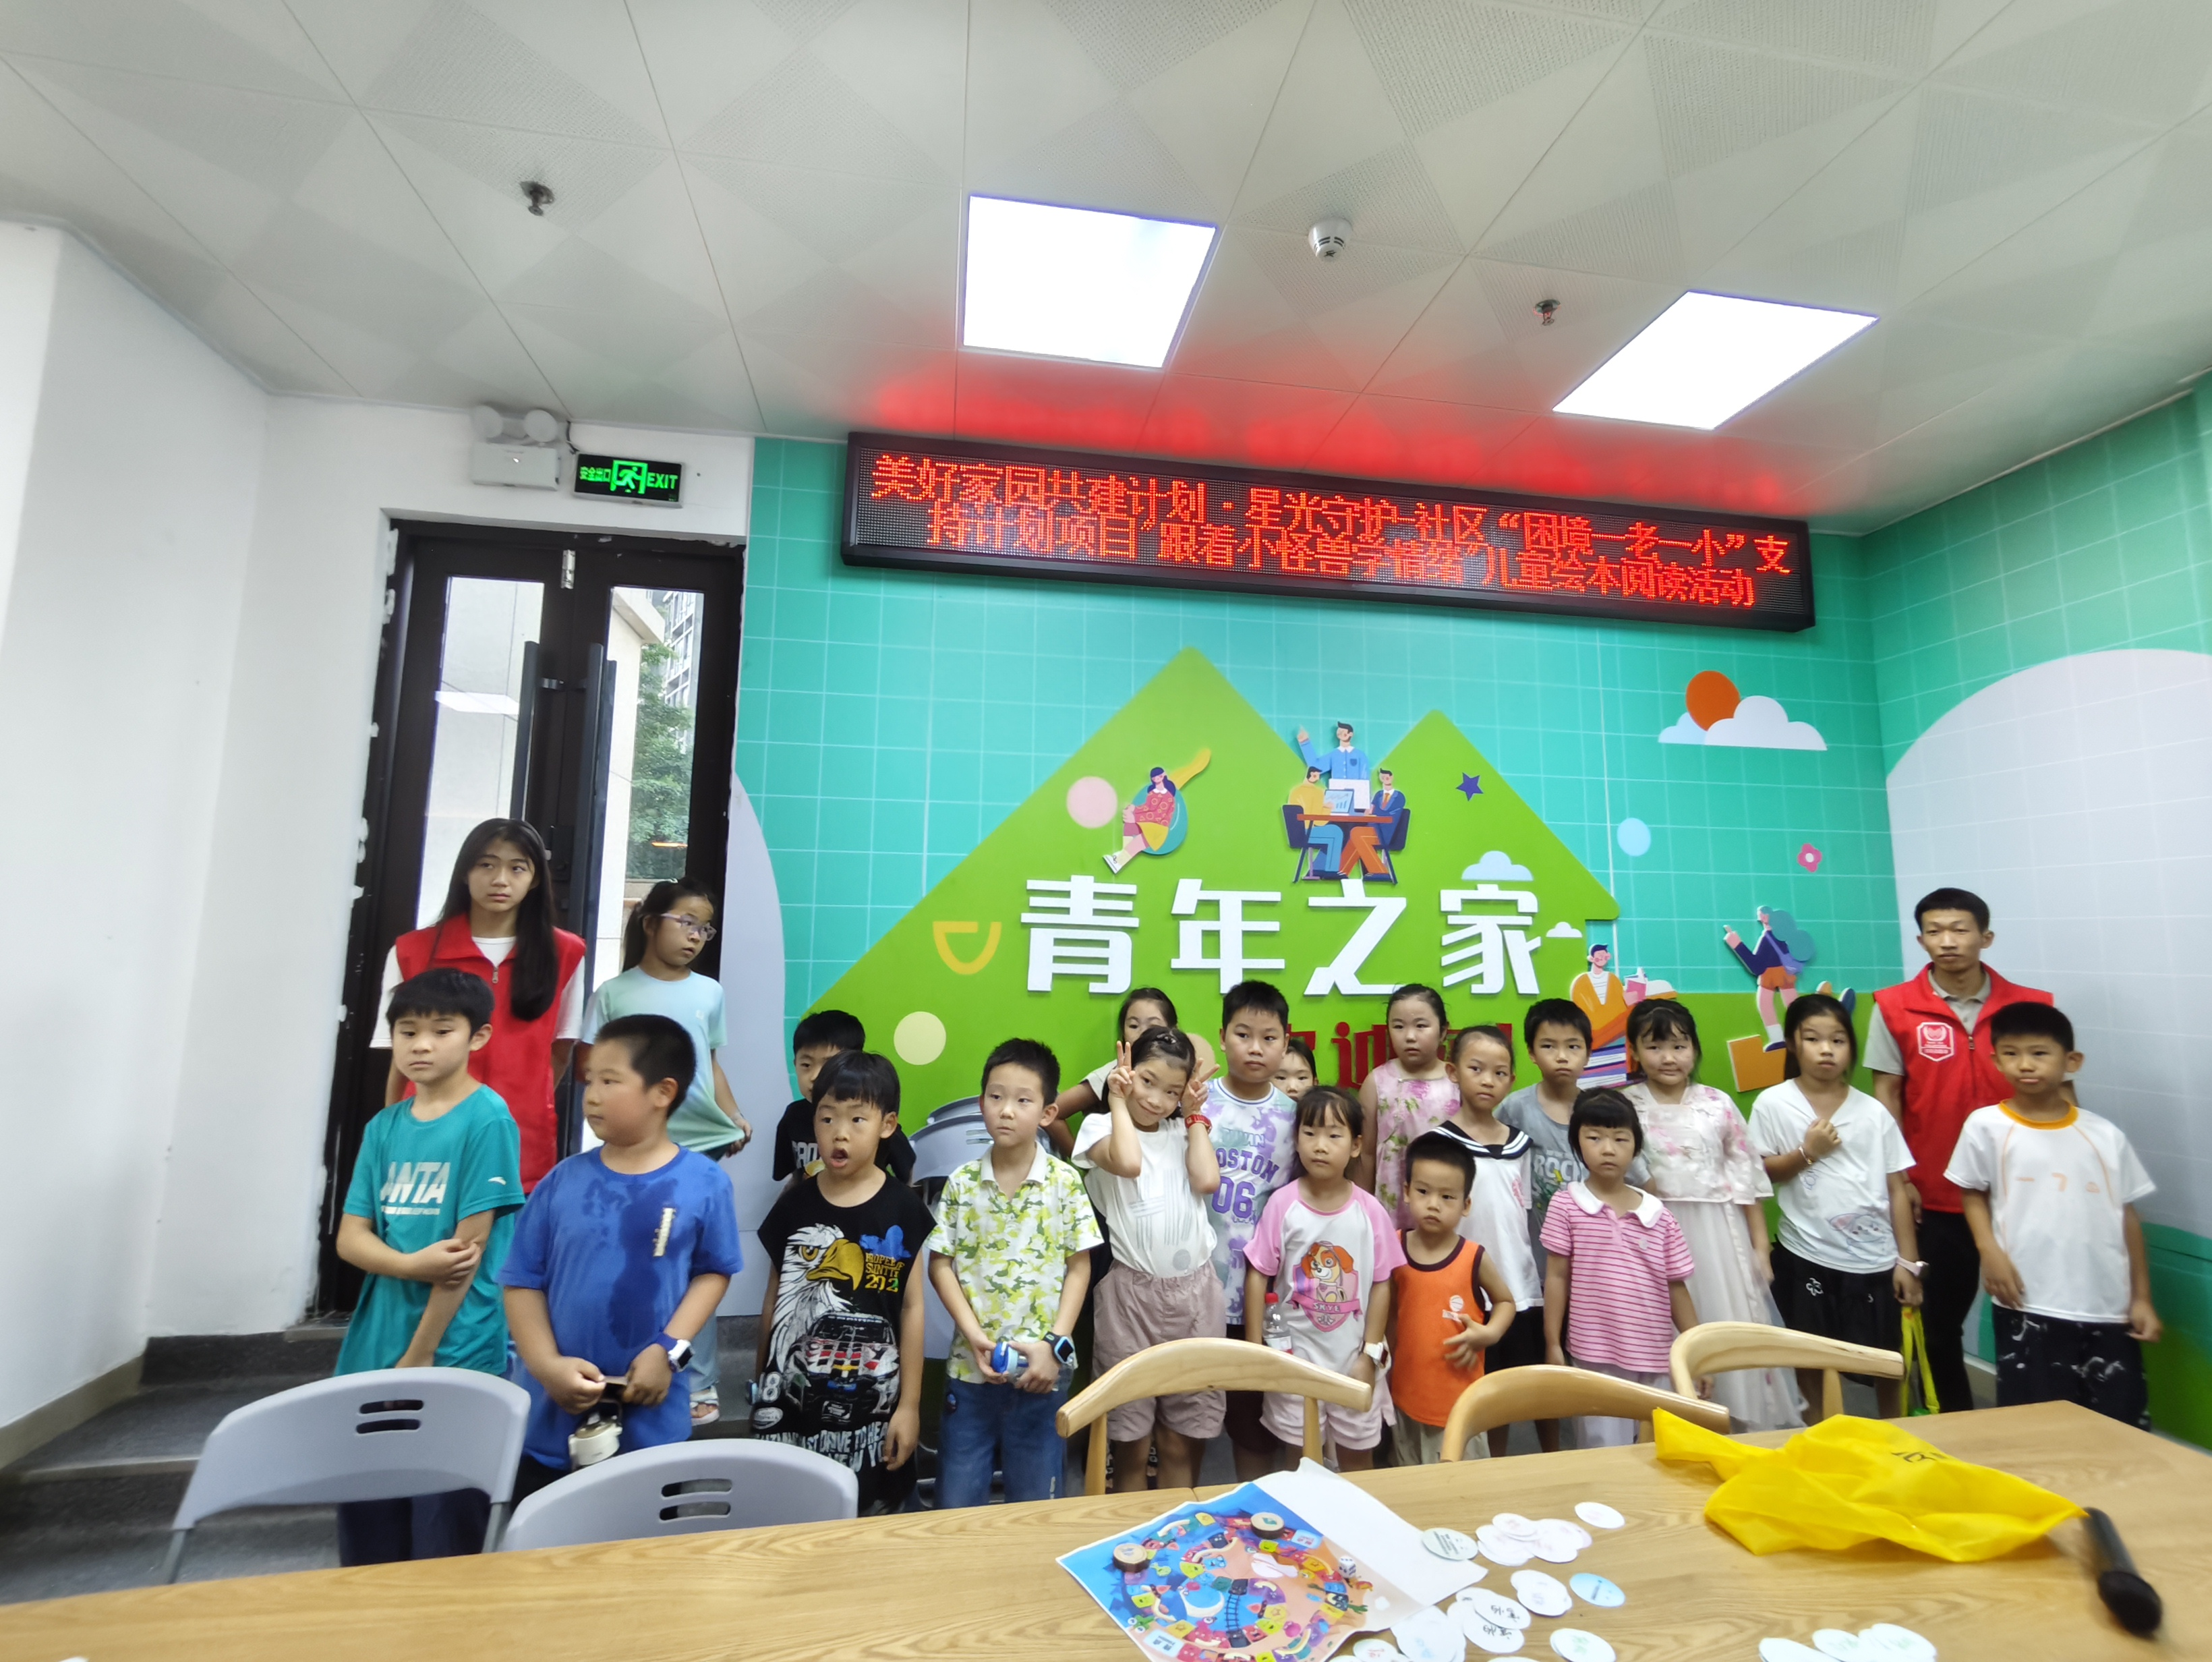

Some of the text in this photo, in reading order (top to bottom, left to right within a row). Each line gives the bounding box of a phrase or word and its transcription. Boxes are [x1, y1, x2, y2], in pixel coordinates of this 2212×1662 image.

[647, 472, 678, 489] EXIT
[1020, 875, 1542, 996] 青年之家
[380, 1161, 450, 1203] ANTA
[1216, 1147, 1279, 1183] OSTON
[1212, 1176, 1255, 1219] 06
[1312, 1302, 1341, 1313] SKYE
